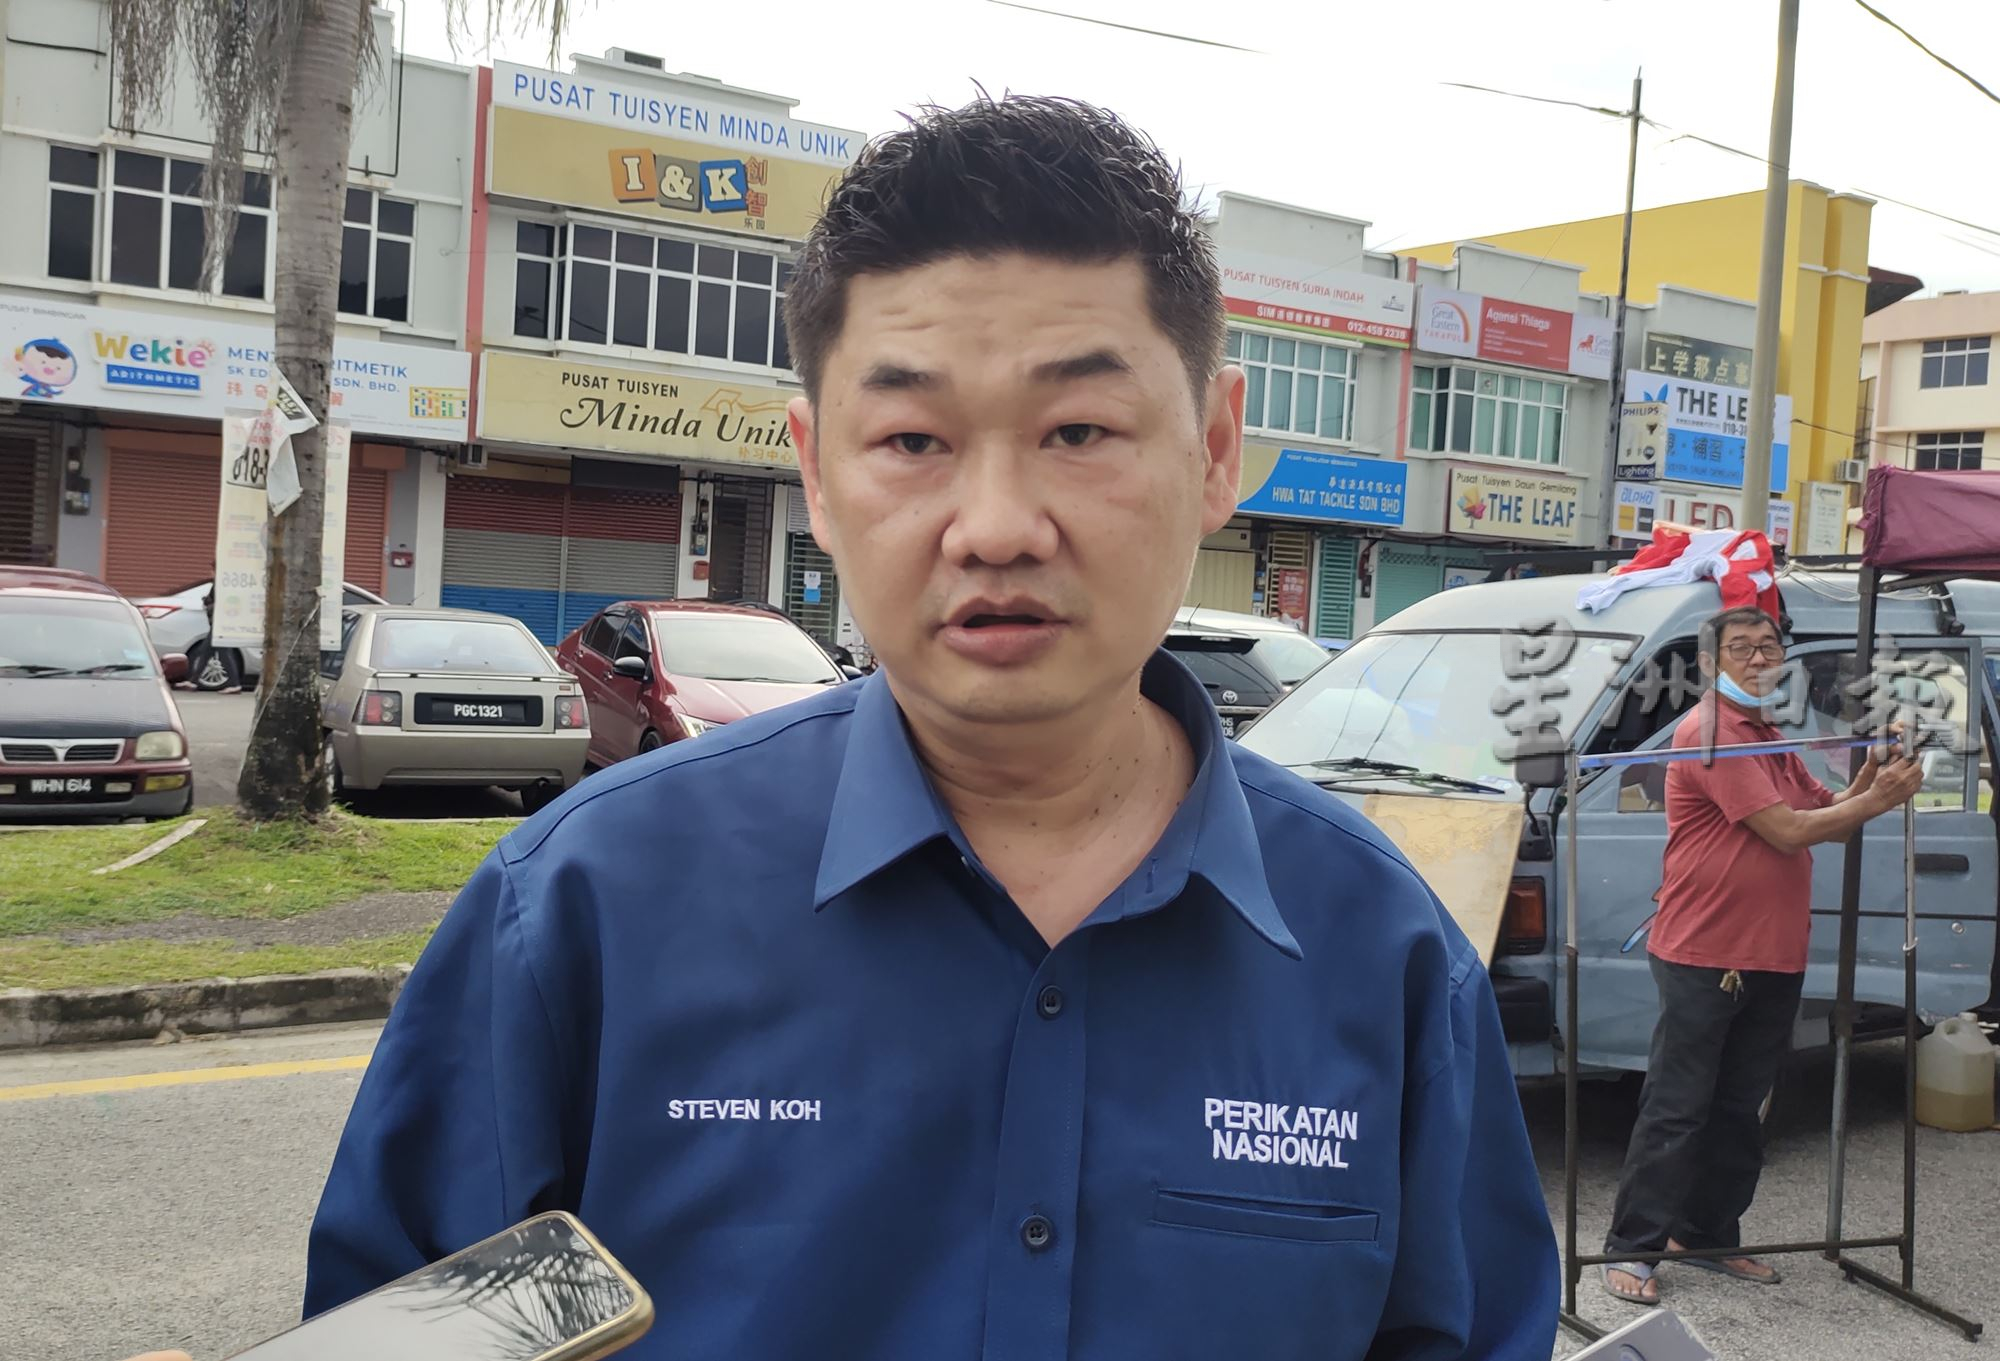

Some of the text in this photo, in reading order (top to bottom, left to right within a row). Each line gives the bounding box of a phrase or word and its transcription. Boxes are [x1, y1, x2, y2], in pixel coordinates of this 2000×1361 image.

[514, 73, 849, 159] PUSAT TUISYEN MINDA UNIK
[1223, 268, 1256, 283] PUSAT
[1258, 274, 1300, 292] TUISYEN
[1333, 289, 1365, 303] INDAH
[94, 331, 207, 369] Wekie
[110, 369, 197, 387] ARITHMETIC
[562, 372, 679, 398] PUSAT TUISYEN
[1622, 405, 1660, 417] PHILIPS
[1676, 386, 1718, 417] THE
[560, 397, 793, 448] Minda Unik
[1456, 472, 1478, 484] Pusat
[1482, 475, 1511, 488] Tuisyen
[1540, 482, 1577, 496] Gemilang
[1618, 464, 1656, 479] Lighting
[1272, 486, 1400, 514] HWA TAT TACKLE SDN BHD
[1488, 493, 1576, 528] THE LEAF
[66, 779, 92, 793] 614
[668, 1099, 821, 1121] STEVEN KOH
[1204, 1098, 1358, 1140] PERIKATAN
[1213, 1129, 1349, 1168] NASIONAL
